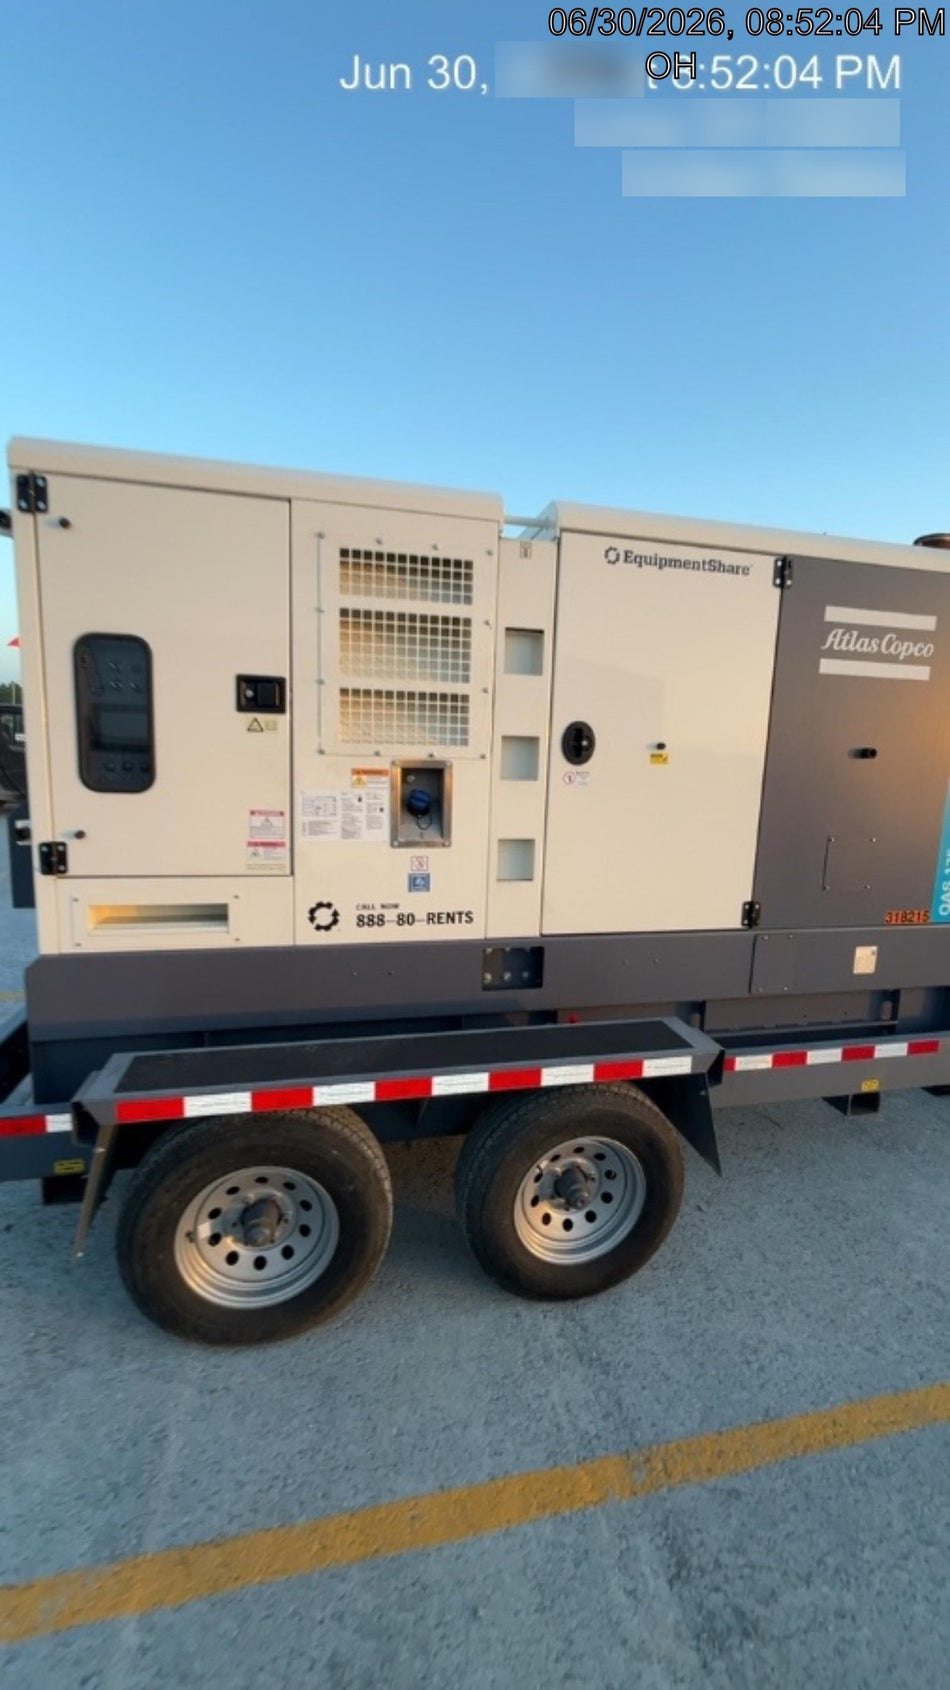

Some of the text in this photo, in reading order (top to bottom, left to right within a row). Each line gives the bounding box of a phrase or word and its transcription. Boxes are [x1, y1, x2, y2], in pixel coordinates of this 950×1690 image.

[623, 550, 750, 576] EquipmentShare
[820, 628, 934, 660] Atlas Copco
